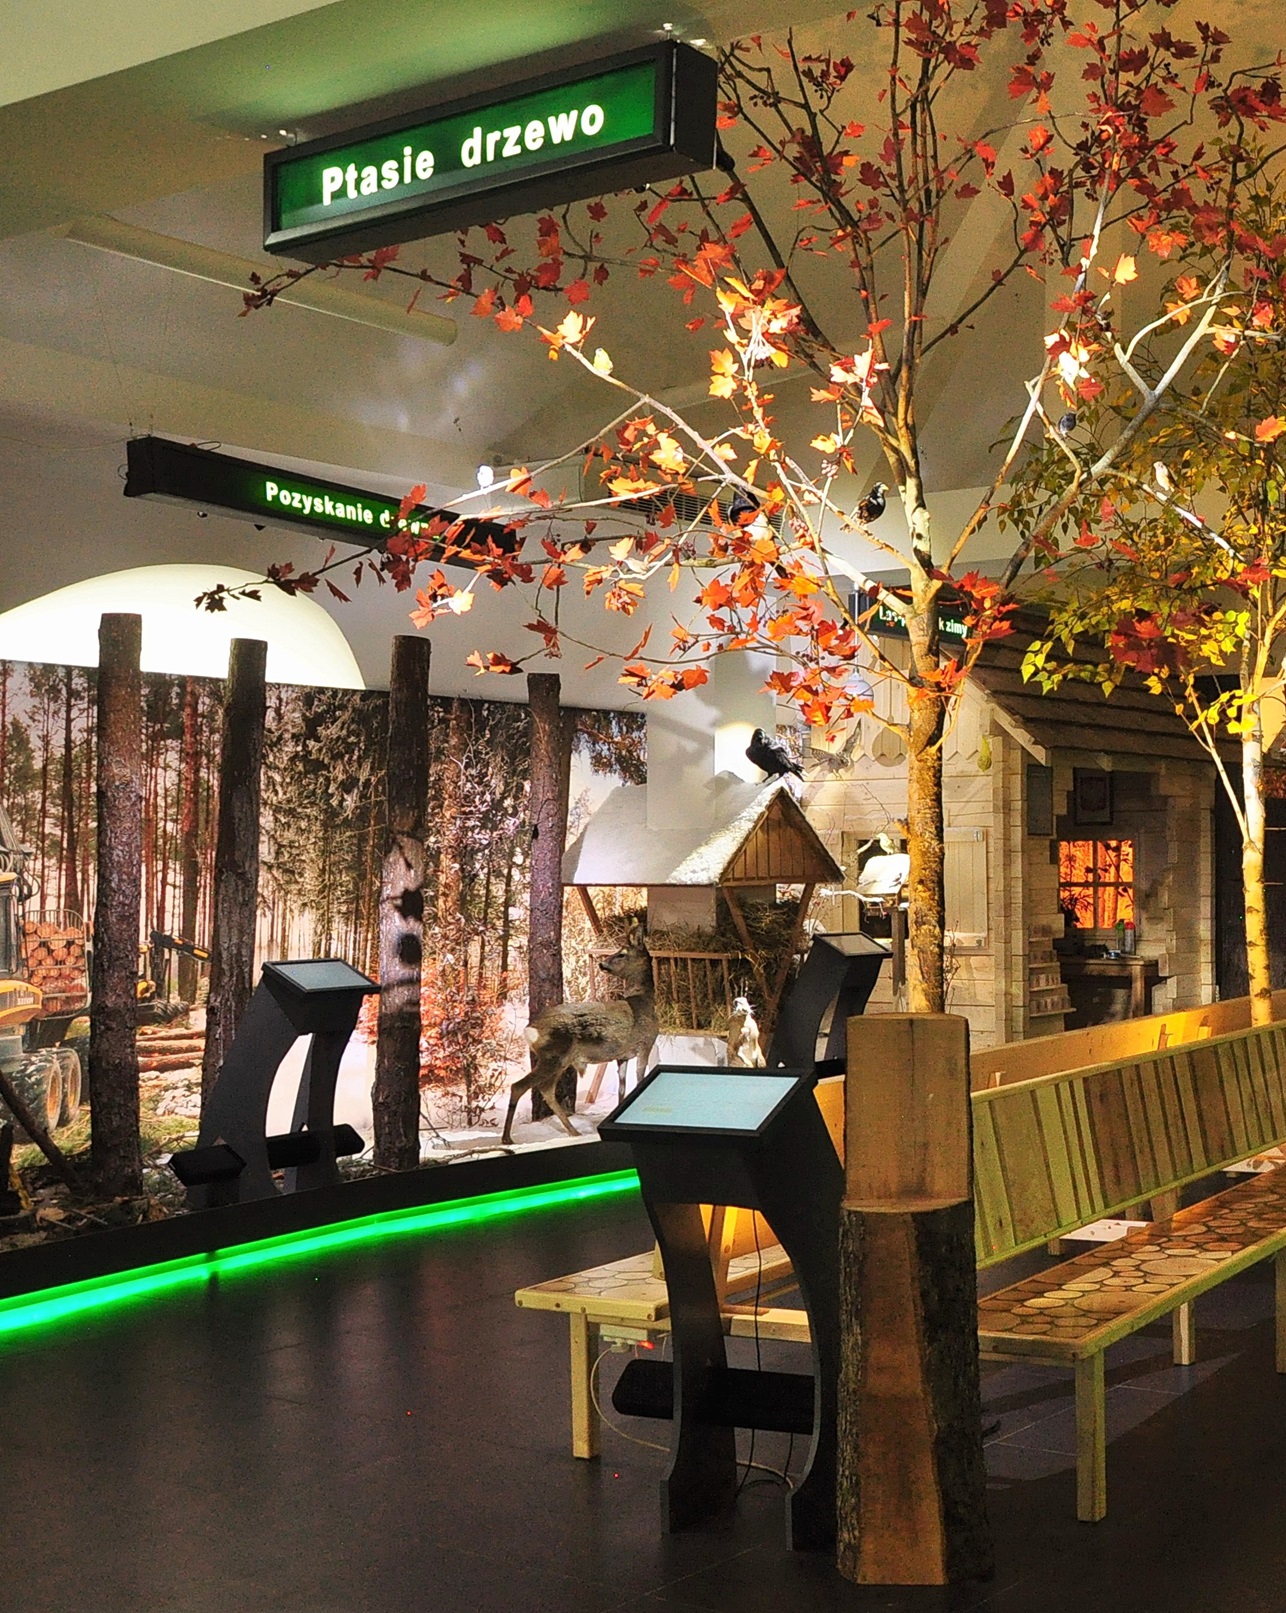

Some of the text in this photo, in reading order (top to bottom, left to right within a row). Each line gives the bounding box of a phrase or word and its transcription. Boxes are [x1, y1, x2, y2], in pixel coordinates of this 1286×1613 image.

[323, 104, 605, 206] Ptasie drzewo
[265, 481, 374, 524] Pozyskanie
[879, 605, 898, 622] Las
[946, 619, 968, 639] zimy
